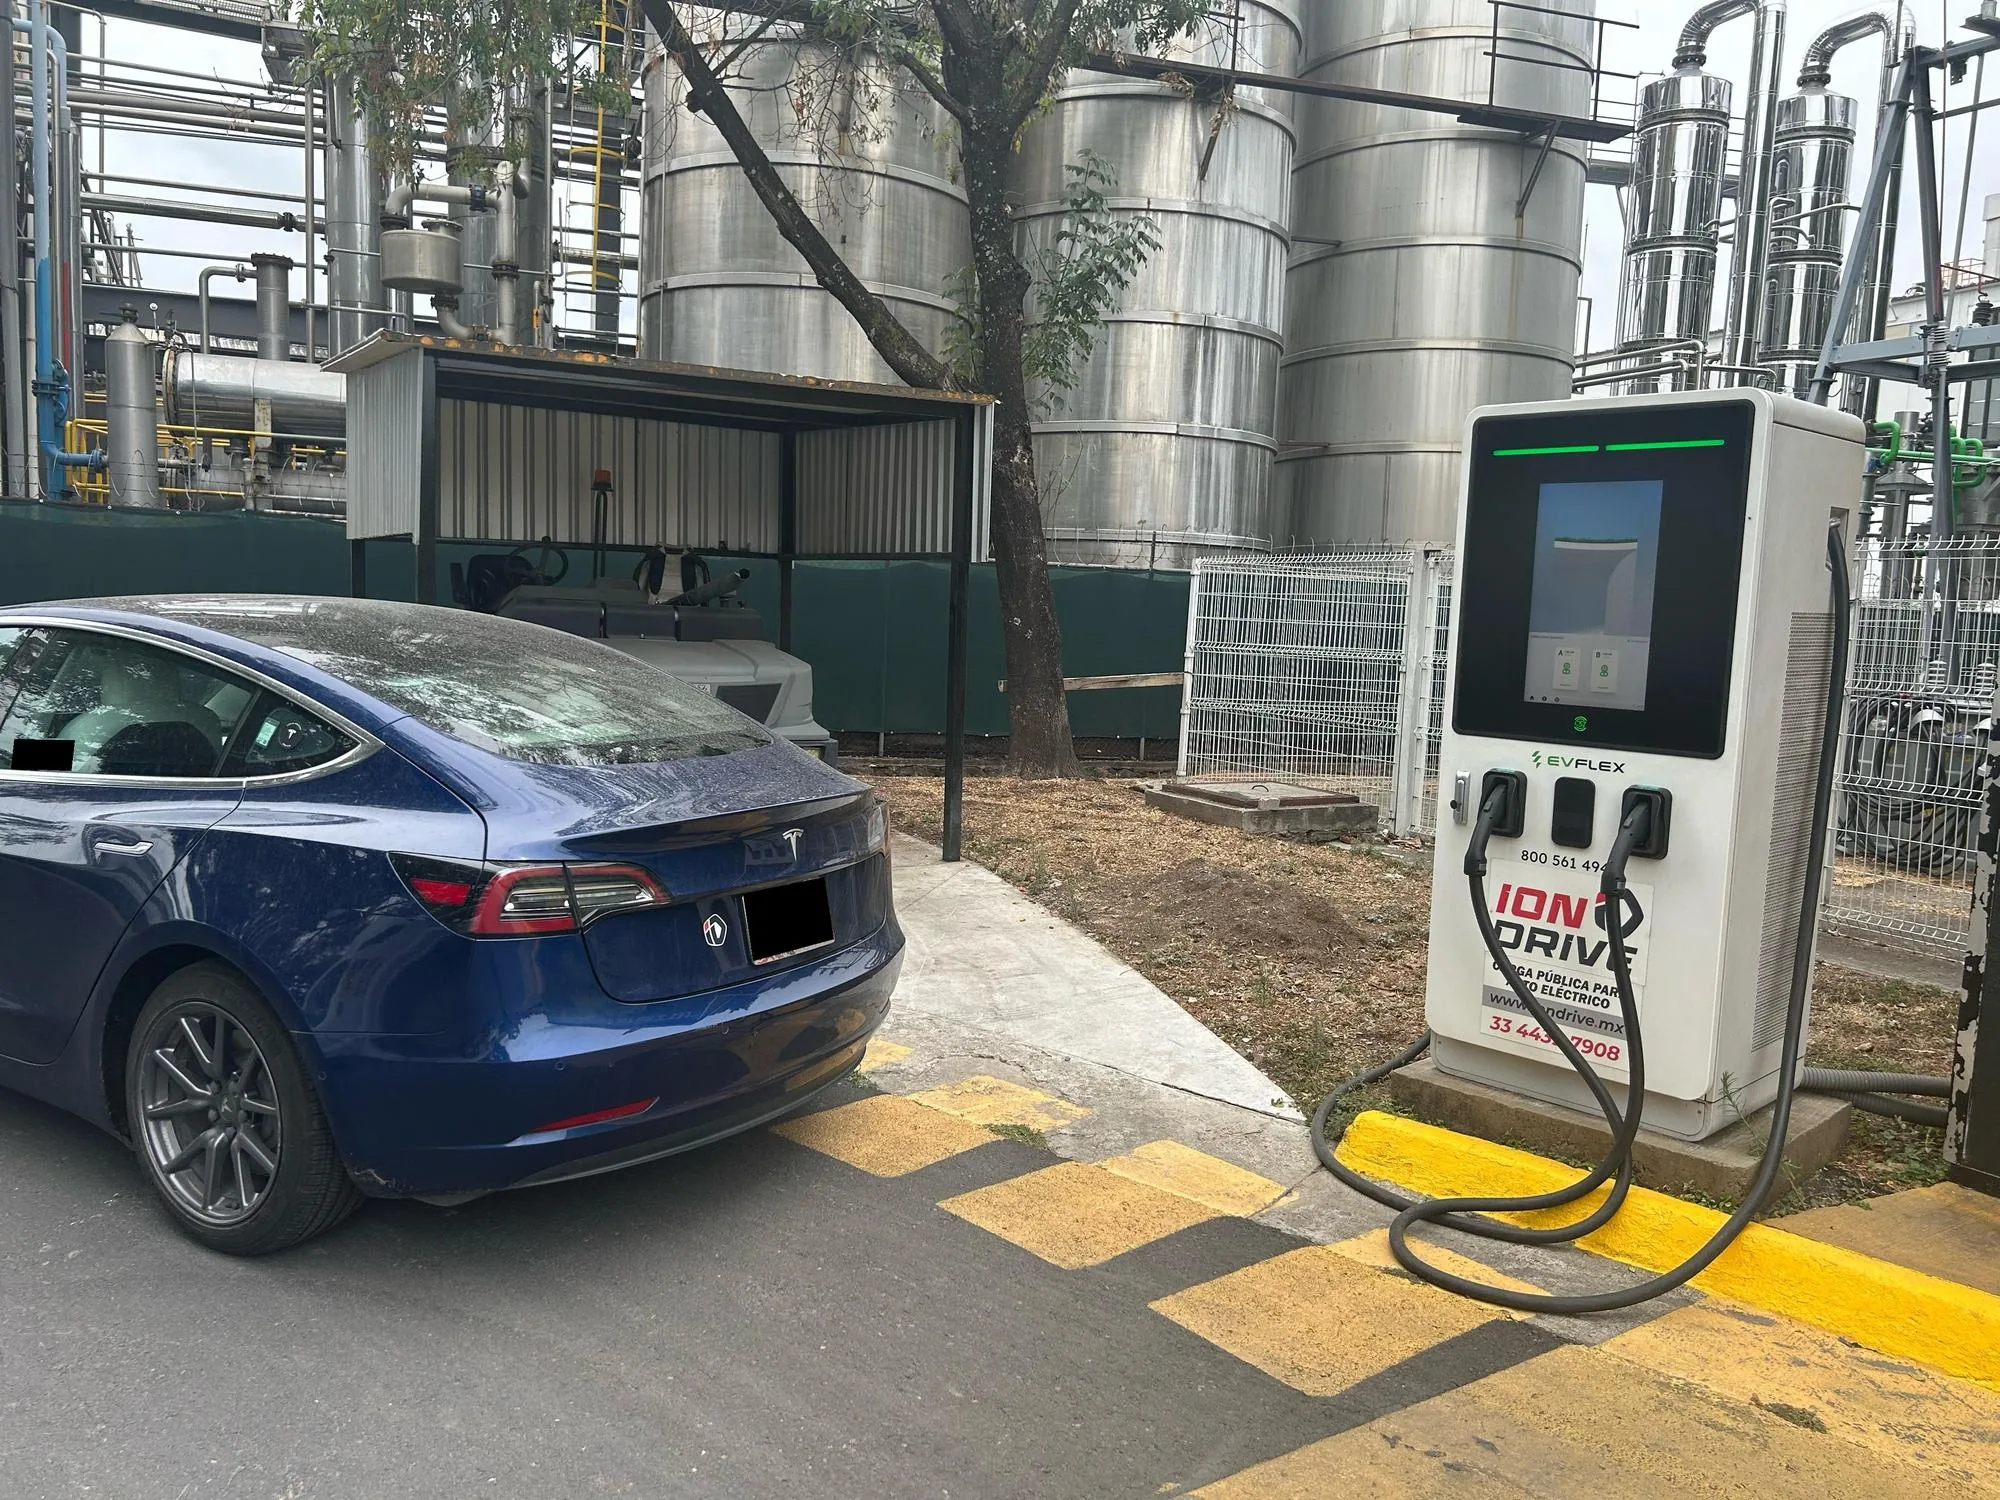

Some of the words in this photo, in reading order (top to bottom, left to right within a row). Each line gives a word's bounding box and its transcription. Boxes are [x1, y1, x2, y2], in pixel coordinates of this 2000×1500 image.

[1547, 755, 1625, 774] EVFLEX
[1521, 850, 1547, 864] 800
[1552, 855, 1576, 870] 561
[1496, 883, 1589, 929] ION
[1492, 961, 1536, 979] CGA
[1536, 970, 1589, 992] PÚBLICA
[1593, 983, 1621, 999] PAR
[1541, 985, 1611, 1009] ELÉCTRICO
[1489, 1015, 1512, 1033] 33
[1570, 1035, 1621, 1061] 7908
